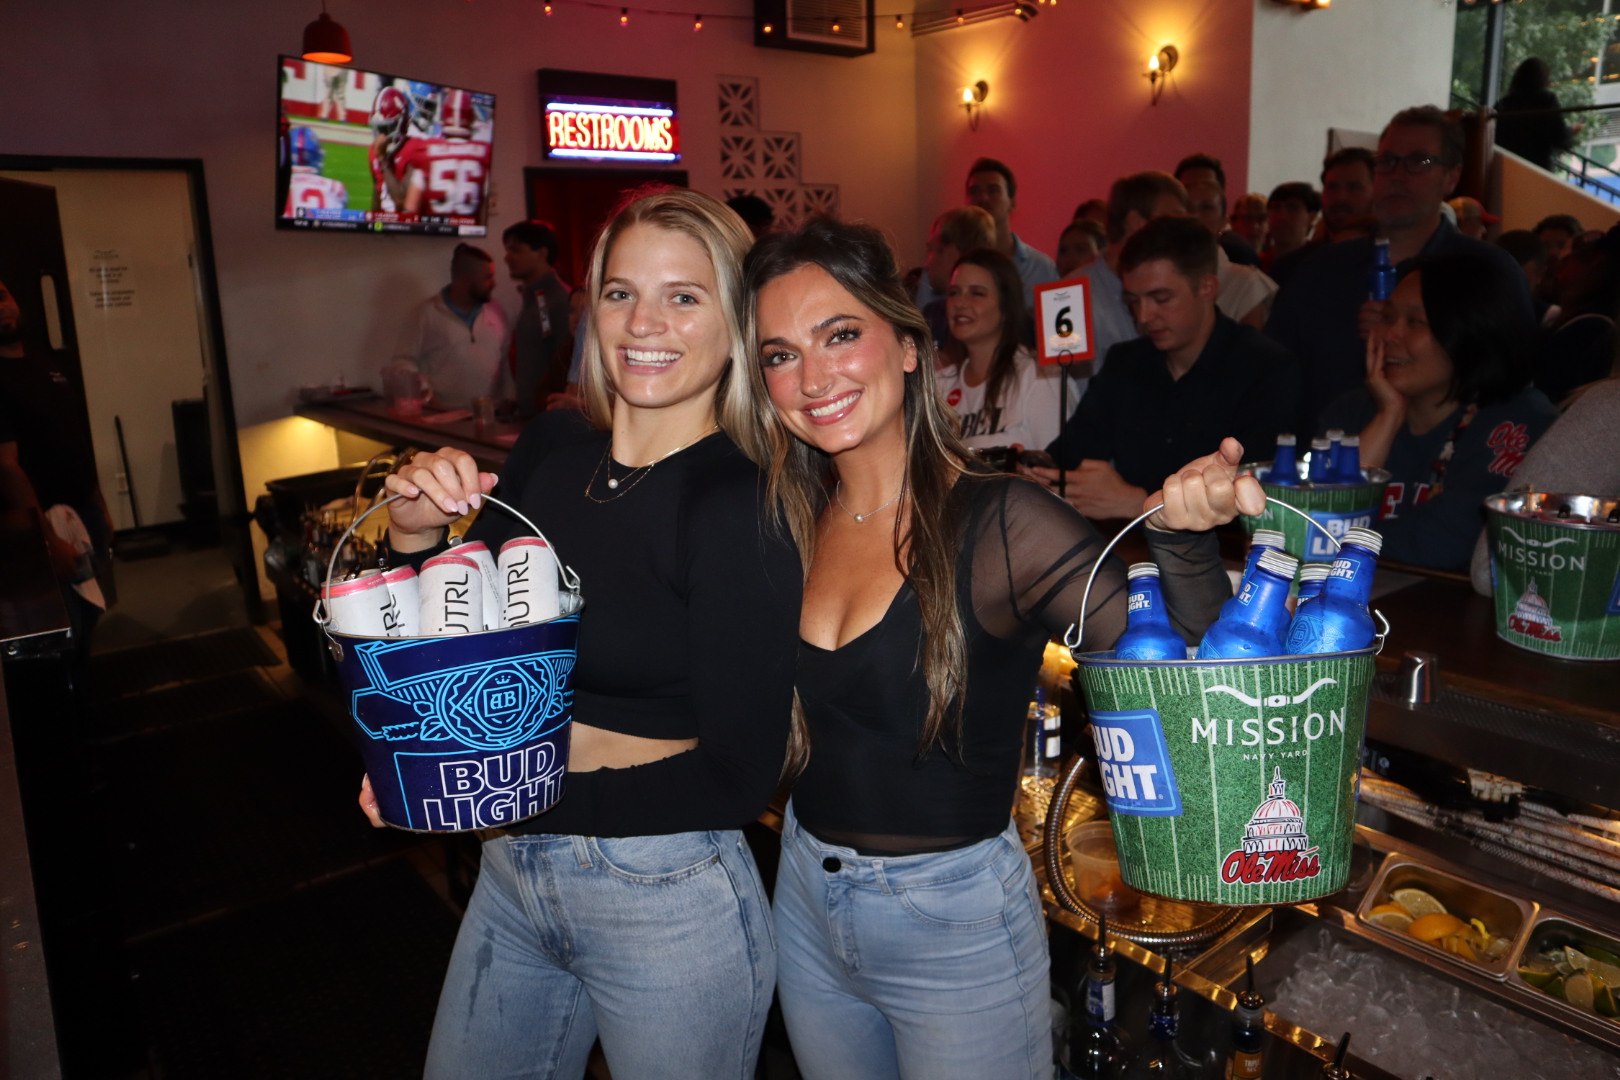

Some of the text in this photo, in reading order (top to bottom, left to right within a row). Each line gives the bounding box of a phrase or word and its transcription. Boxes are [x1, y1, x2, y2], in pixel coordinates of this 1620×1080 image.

[549, 111, 673, 151] RESTROOMS
[430, 159, 482, 214] 56
[1055, 305, 1073, 338] 6
[958, 407, 1005, 438] BEL
[1330, 569, 1354, 580] GHT
[1499, 541, 1585, 571] MISSION
[439, 571, 469, 633] TRL
[1191, 706, 1345, 746] MISSION
[439, 741, 555, 798] BUD
[1243, 750, 1308, 761] NAVY YARD
[422, 764, 564, 831] LIGHT
[1099, 761, 1158, 800] GHT
[1221, 847, 1321, 885] Ole Miss
